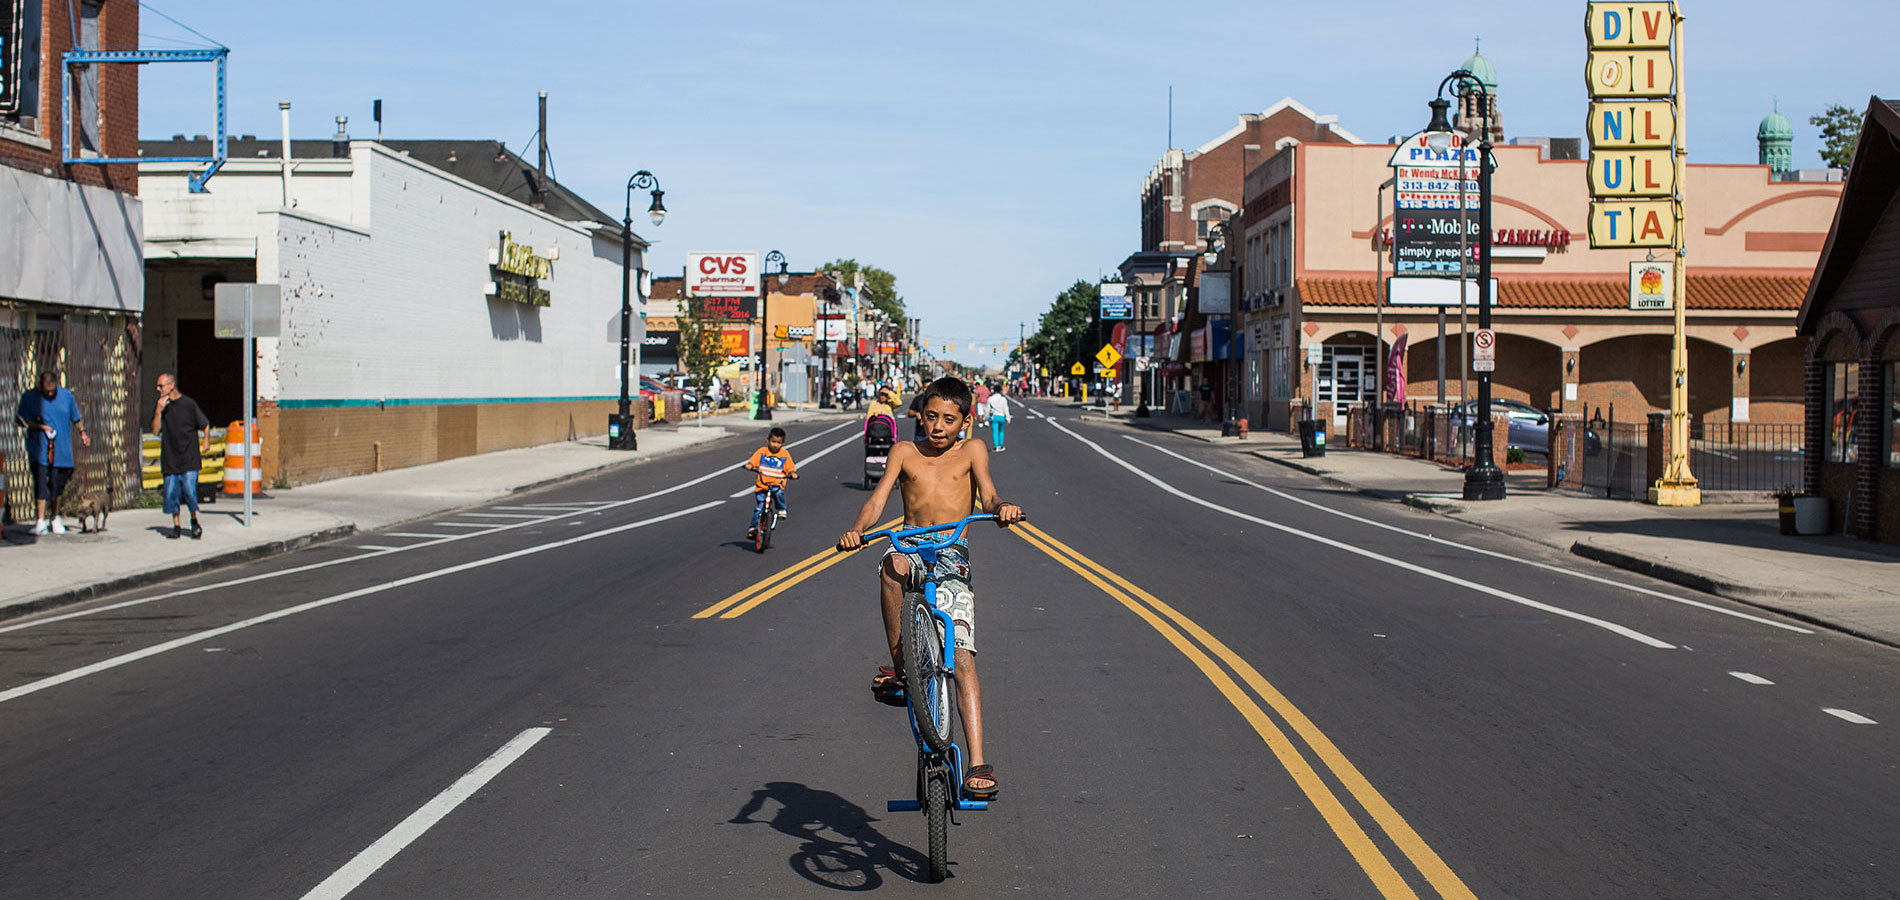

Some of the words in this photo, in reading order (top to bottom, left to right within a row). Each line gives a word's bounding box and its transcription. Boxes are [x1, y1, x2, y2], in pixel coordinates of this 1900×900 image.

[1410, 148, 1477, 161] PLAZA
[1411, 168, 1440, 180] Wendy
[1402, 181, 1481, 190] 313-842-80
[1498, 228, 1569, 246] FAMILIAR
[1399, 246, 1432, 258] simply
[1435, 247, 1472, 258] prepd
[699, 256, 747, 275] CVS
[1397, 261, 1461, 272] PPTS
[699, 276, 745, 285] pharmacy
[1638, 300, 1665, 308] LOTTERY
[731, 311, 750, 319] 2016
[788, 325, 815, 336] boost
[728, 354, 760, 365] boot
